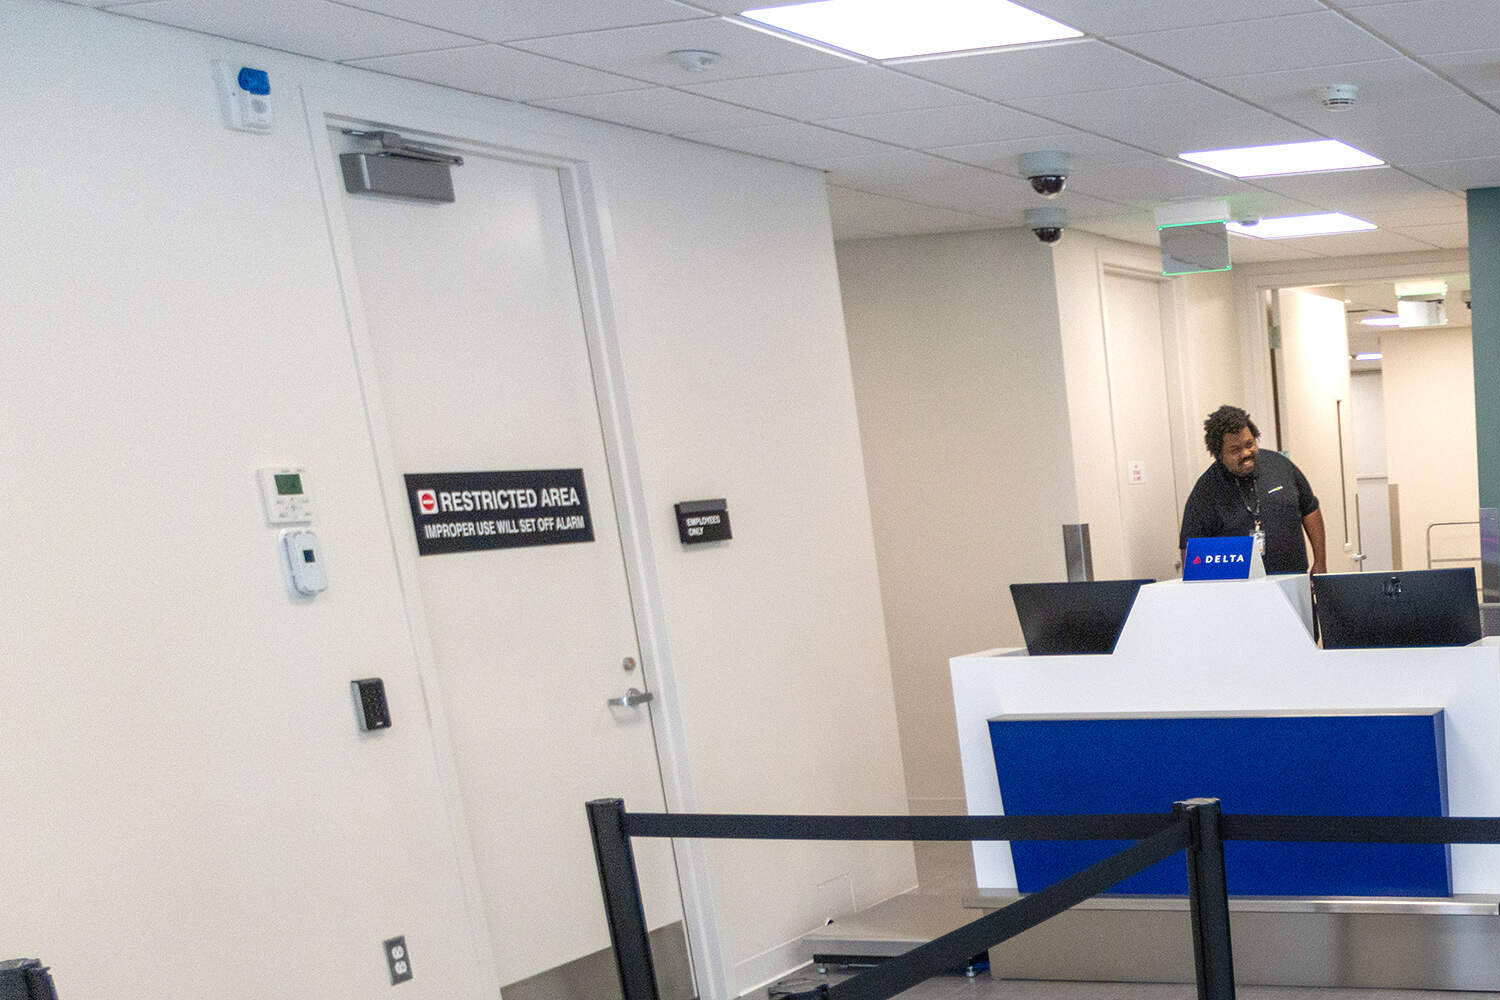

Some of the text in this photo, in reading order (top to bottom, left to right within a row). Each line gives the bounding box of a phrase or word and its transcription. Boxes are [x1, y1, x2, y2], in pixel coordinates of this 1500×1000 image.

[440, 487, 581, 512] RESTRICTED AREA
[424, 515, 585, 539] IMPROPER USE WILL SET OFF ALARM
[686, 514, 720, 527] EMPLOYEES
[688, 526, 704, 536] ONLY
[1205, 554, 1245, 564] DELTA
